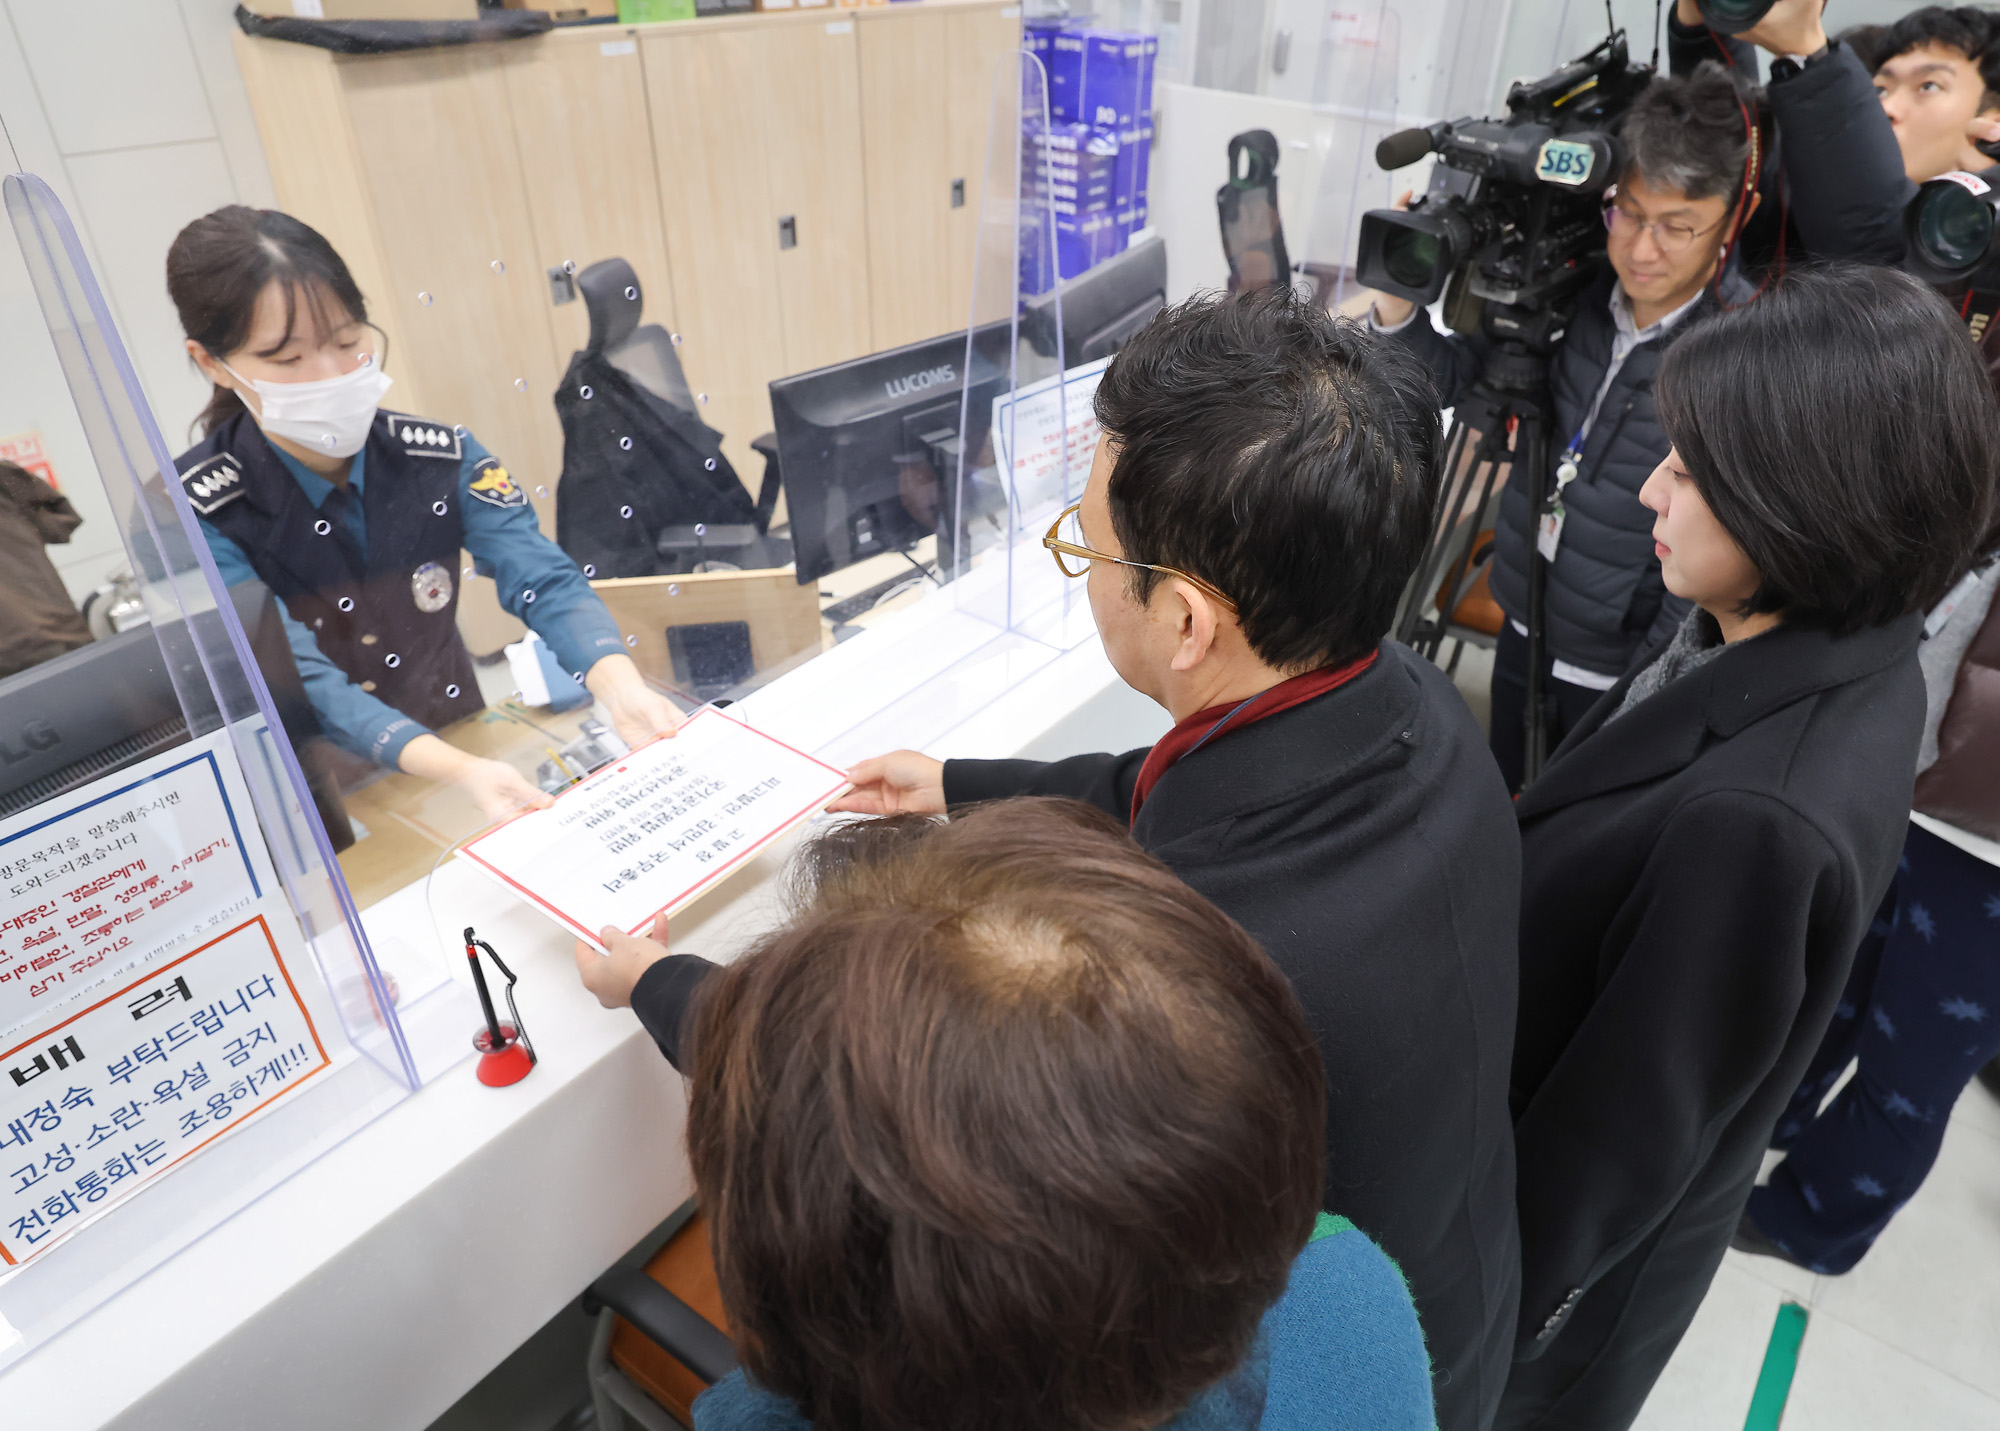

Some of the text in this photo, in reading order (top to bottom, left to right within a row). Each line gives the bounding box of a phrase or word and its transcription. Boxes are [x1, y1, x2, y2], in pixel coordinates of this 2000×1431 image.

[1540, 149, 1589, 175] SBS
[884, 363, 957, 399] LUCOMS
[0, 719, 62, 765] LG
[581, 807, 617, 829] 위반
[720, 776, 782, 815] 피고발인
[0, 791, 182, 880] 방문목적을 말씀해주시면
[605, 832, 642, 855] 위반
[666, 819, 718, 852] 김민석
[10, 832, 139, 898] 도와드리겠습니다
[62, 858, 147, 903] 경찰관에게
[601, 851, 671, 894] 국무총리
[81, 906, 146, 946] 조롱하는
[149, 879, 194, 909] 발언을
[30, 972, 66, 998] 삼가
[69, 935, 134, 975] 주십시오
[107, 974, 276, 1085] 부탁드립니다
[222, 1021, 278, 1068] 금지
[8, 1043, 310, 1245] 전화통화는 조용하게!!!
